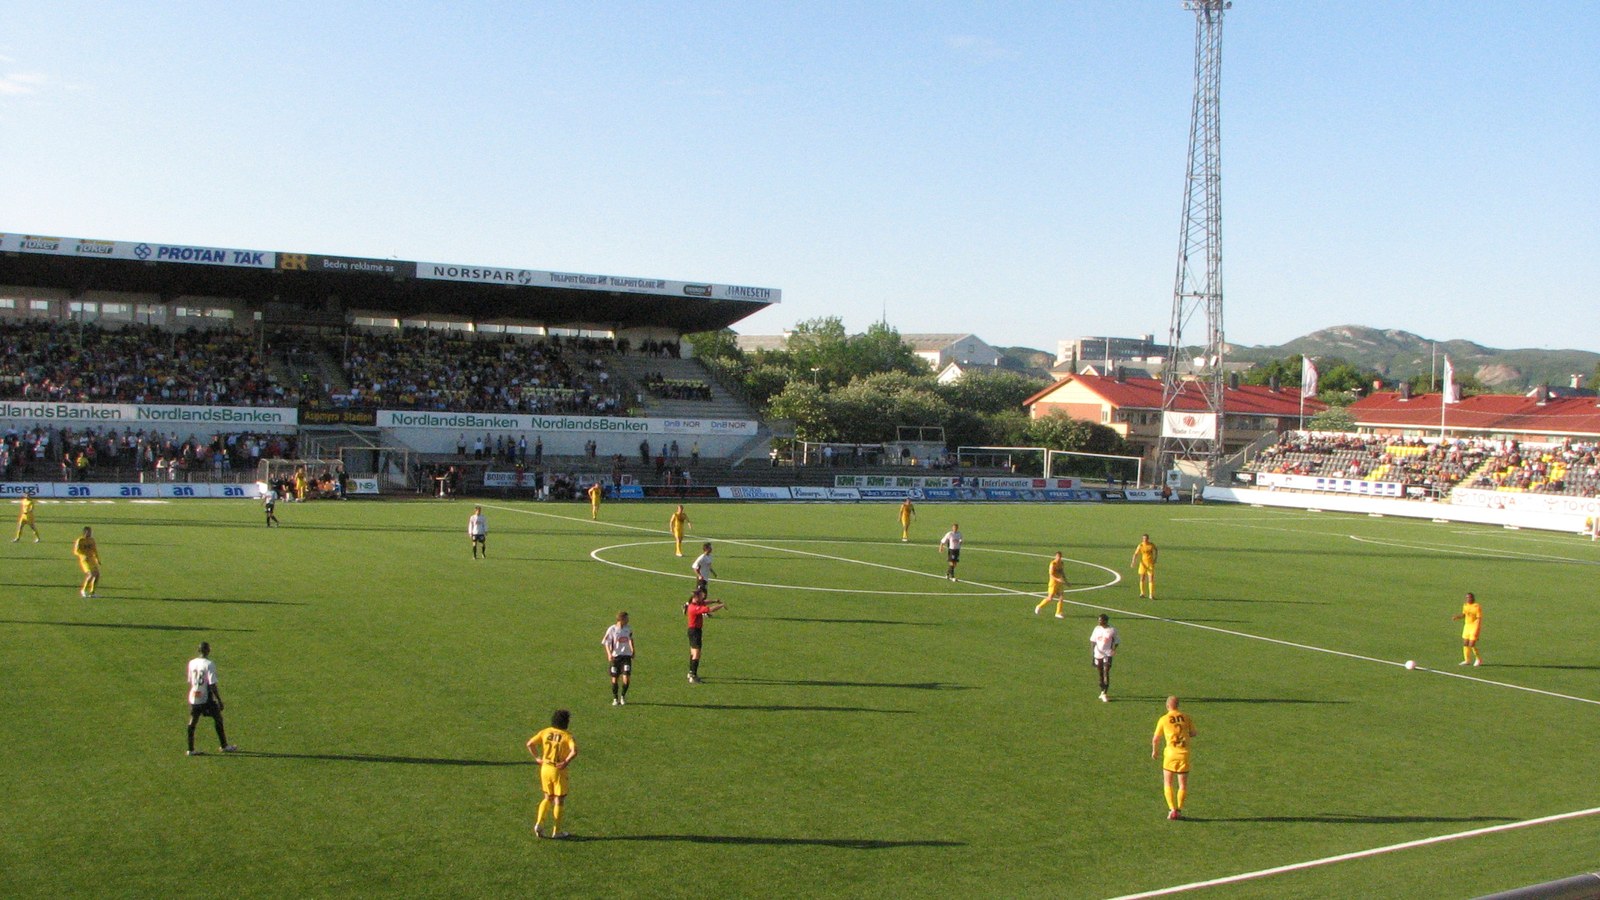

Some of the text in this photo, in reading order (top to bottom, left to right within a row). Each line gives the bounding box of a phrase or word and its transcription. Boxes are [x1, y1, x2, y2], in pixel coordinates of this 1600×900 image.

[157, 247, 264, 265] PROTAN TAK
[323, 259, 394, 272] Bedre reklame as
[434, 266, 514, 281] NORSPAR
[137, 407, 282, 423] NordlandsBanken
[343, 412, 373, 421] Stadion
[392, 413, 518, 428] NordlandsBanken
[531, 417, 648, 431] NordlandsBanken
[728, 421, 746, 429] NOR
[0, 484, 40, 496] Energi
[68, 486, 90, 496] an
[120, 486, 142, 496] an
[173, 486, 195, 496] an
[223, 486, 244, 496] an
[1472, 493, 1516, 504] TOYOTA
[1169, 715, 1185, 724] an
